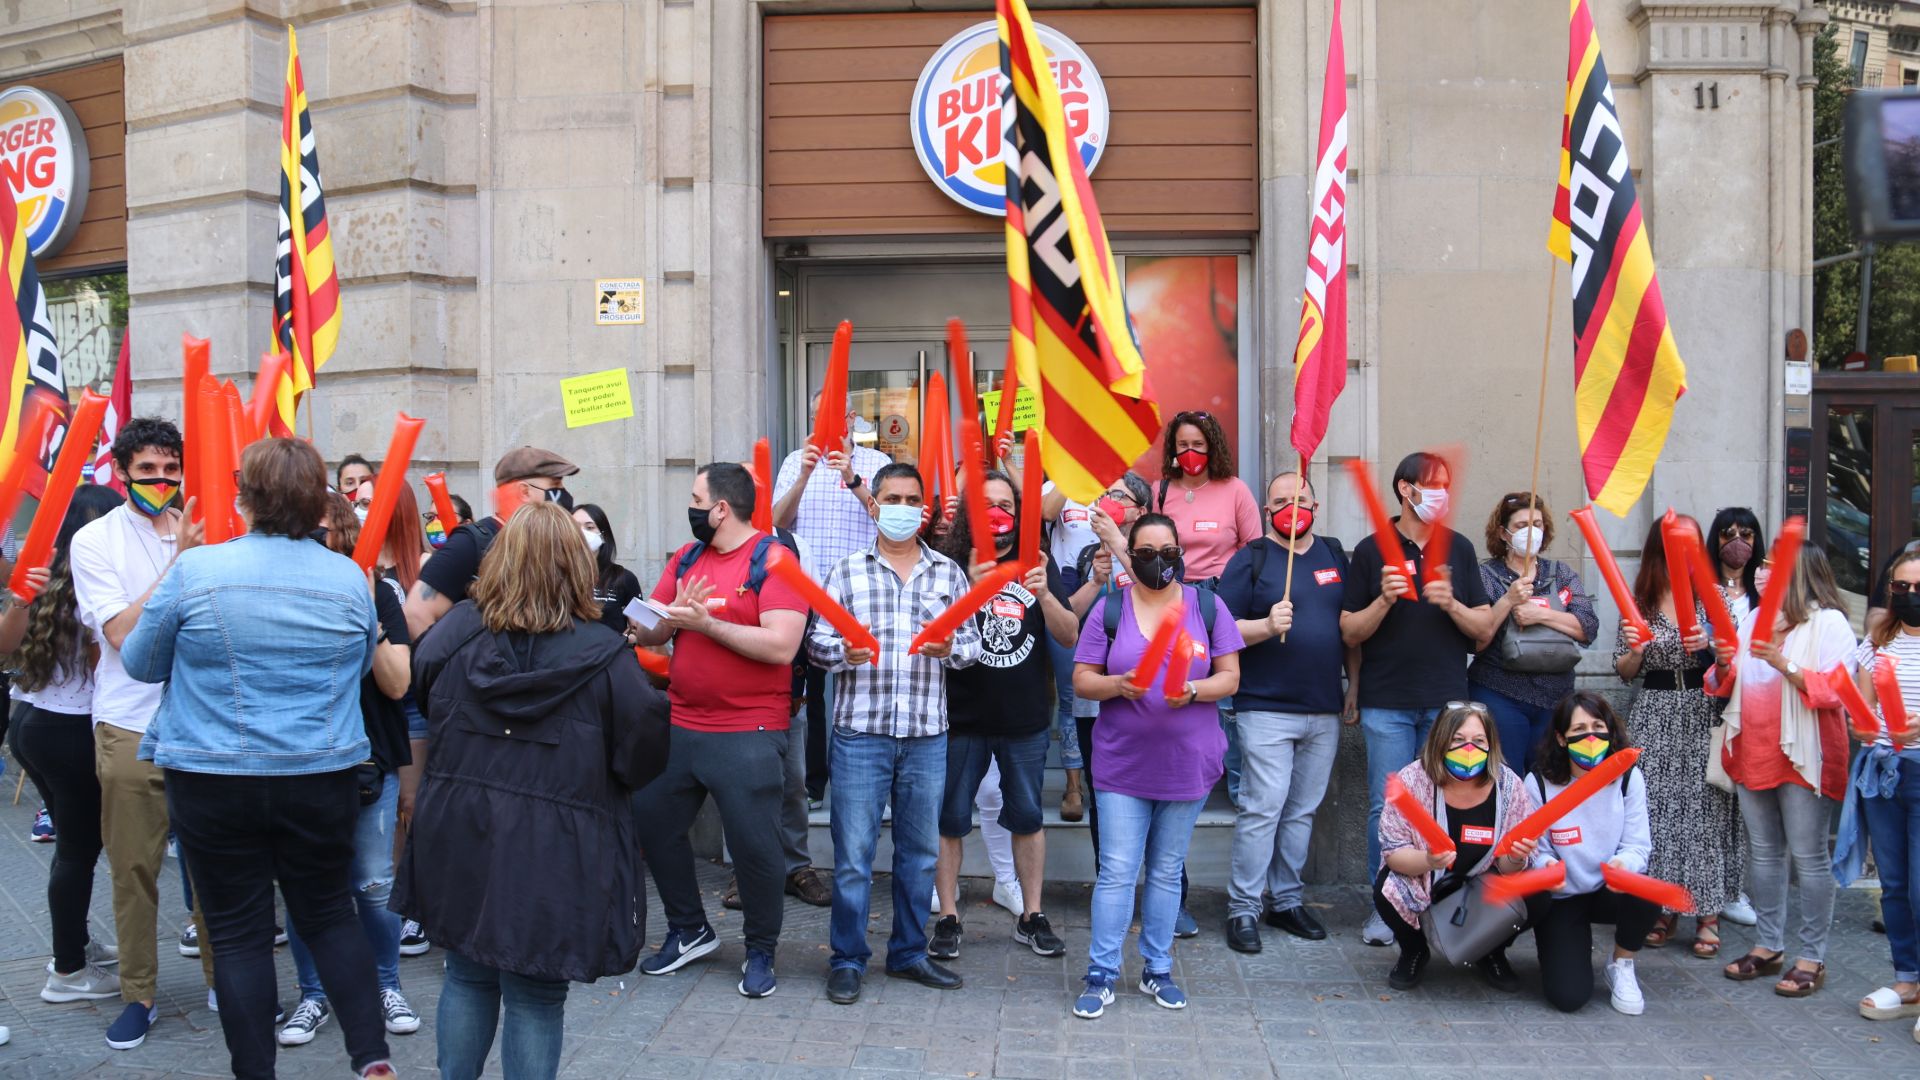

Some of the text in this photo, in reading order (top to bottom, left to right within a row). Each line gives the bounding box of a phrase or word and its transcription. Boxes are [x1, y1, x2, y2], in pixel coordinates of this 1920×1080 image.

[938, 60, 1083, 128] BURR
[1694, 81, 1719, 109] 11
[945, 91, 1089, 177] KIG
[568, 381, 622, 396] Tanquem avui
[578, 392, 615, 405] per poder
[570, 404, 603, 415] treballar
[1003, 583, 1034, 604] ARQUIA
